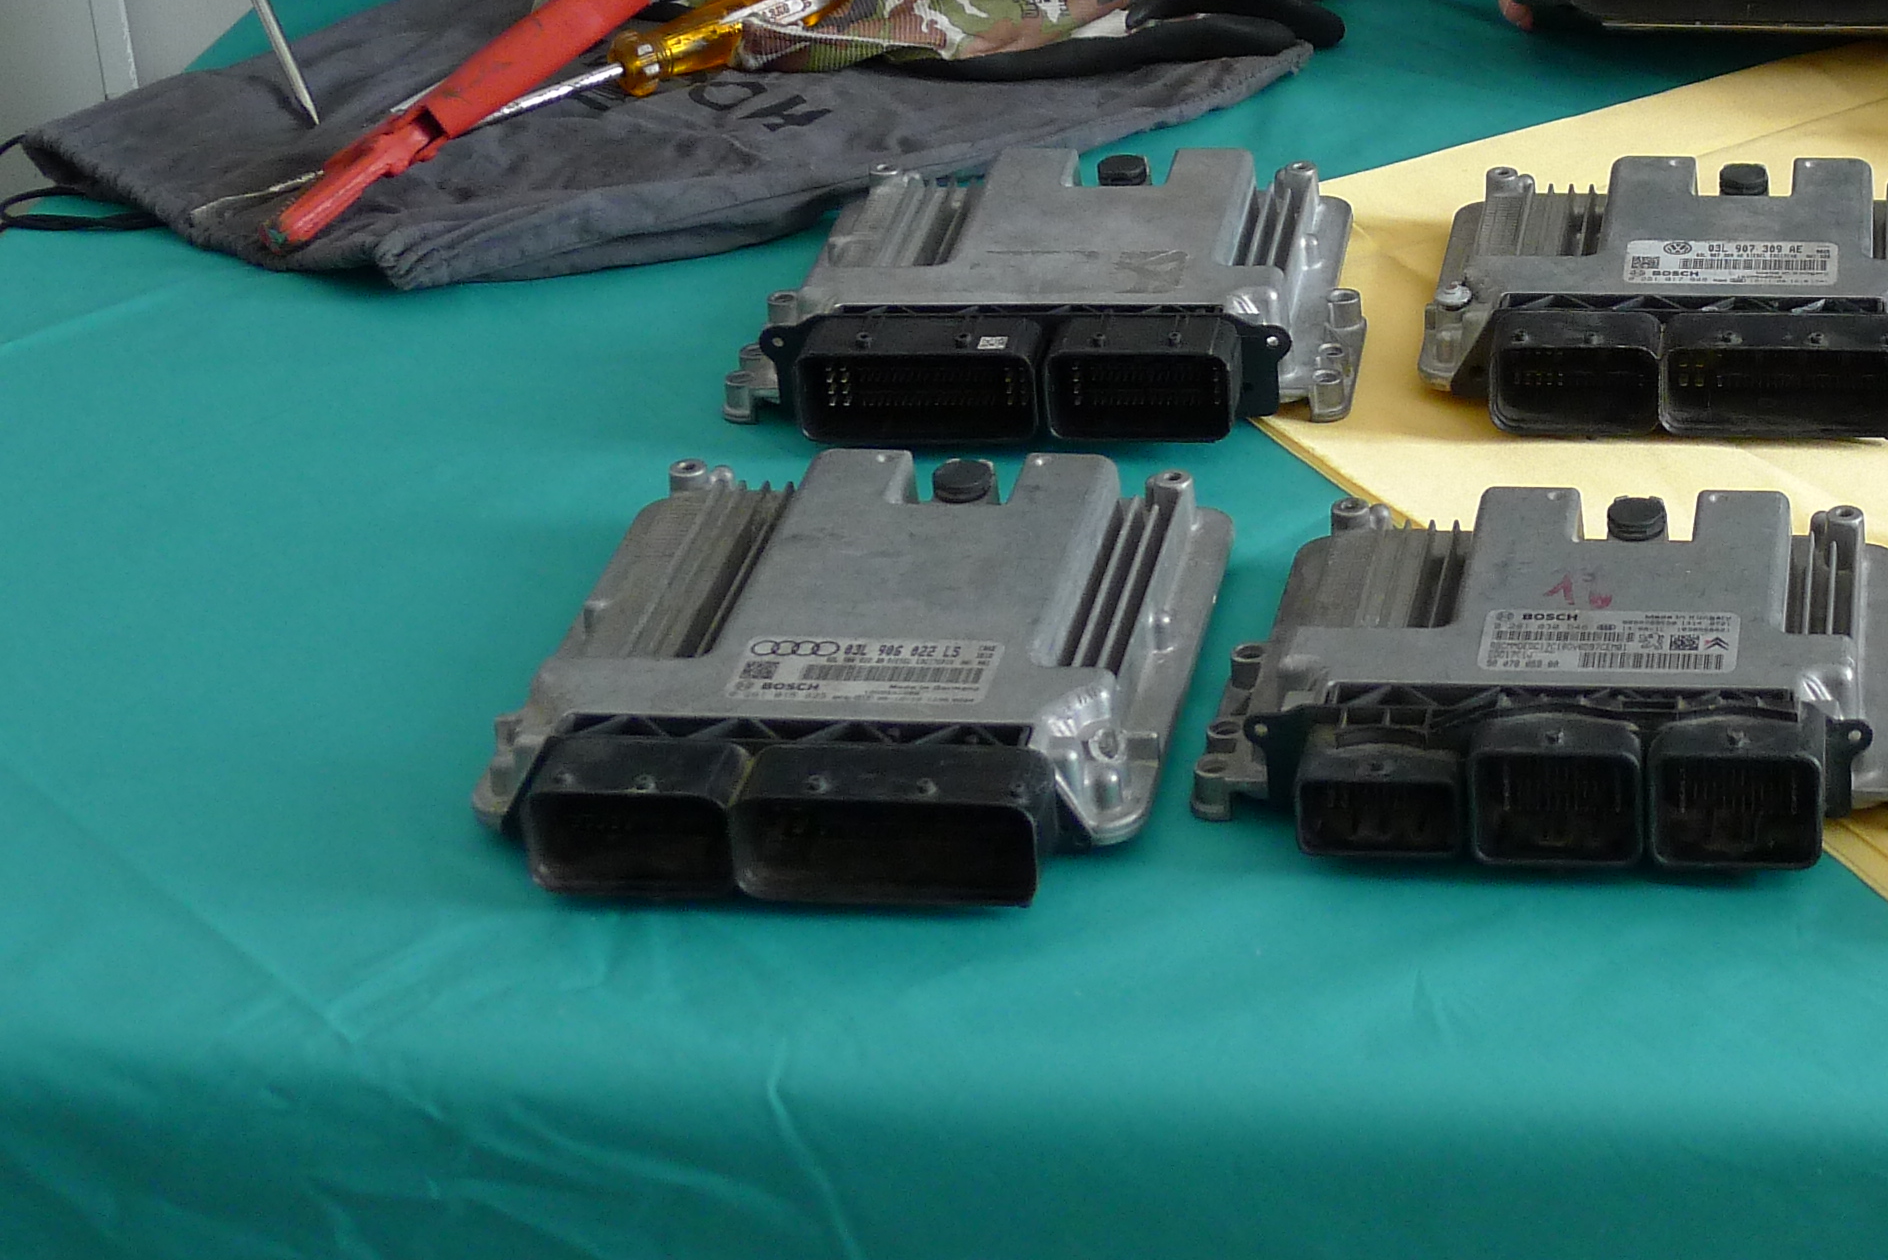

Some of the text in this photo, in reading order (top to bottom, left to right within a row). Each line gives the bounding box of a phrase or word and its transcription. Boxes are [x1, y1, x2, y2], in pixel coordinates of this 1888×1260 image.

[1708, 244, 1803, 253] 03L 907 309 AE
[1522, 613, 1578, 621] BOSCH
[844, 644, 867, 655] 03L
[910, 645, 938, 657] 022
[761, 682, 820, 690] BOSCH
